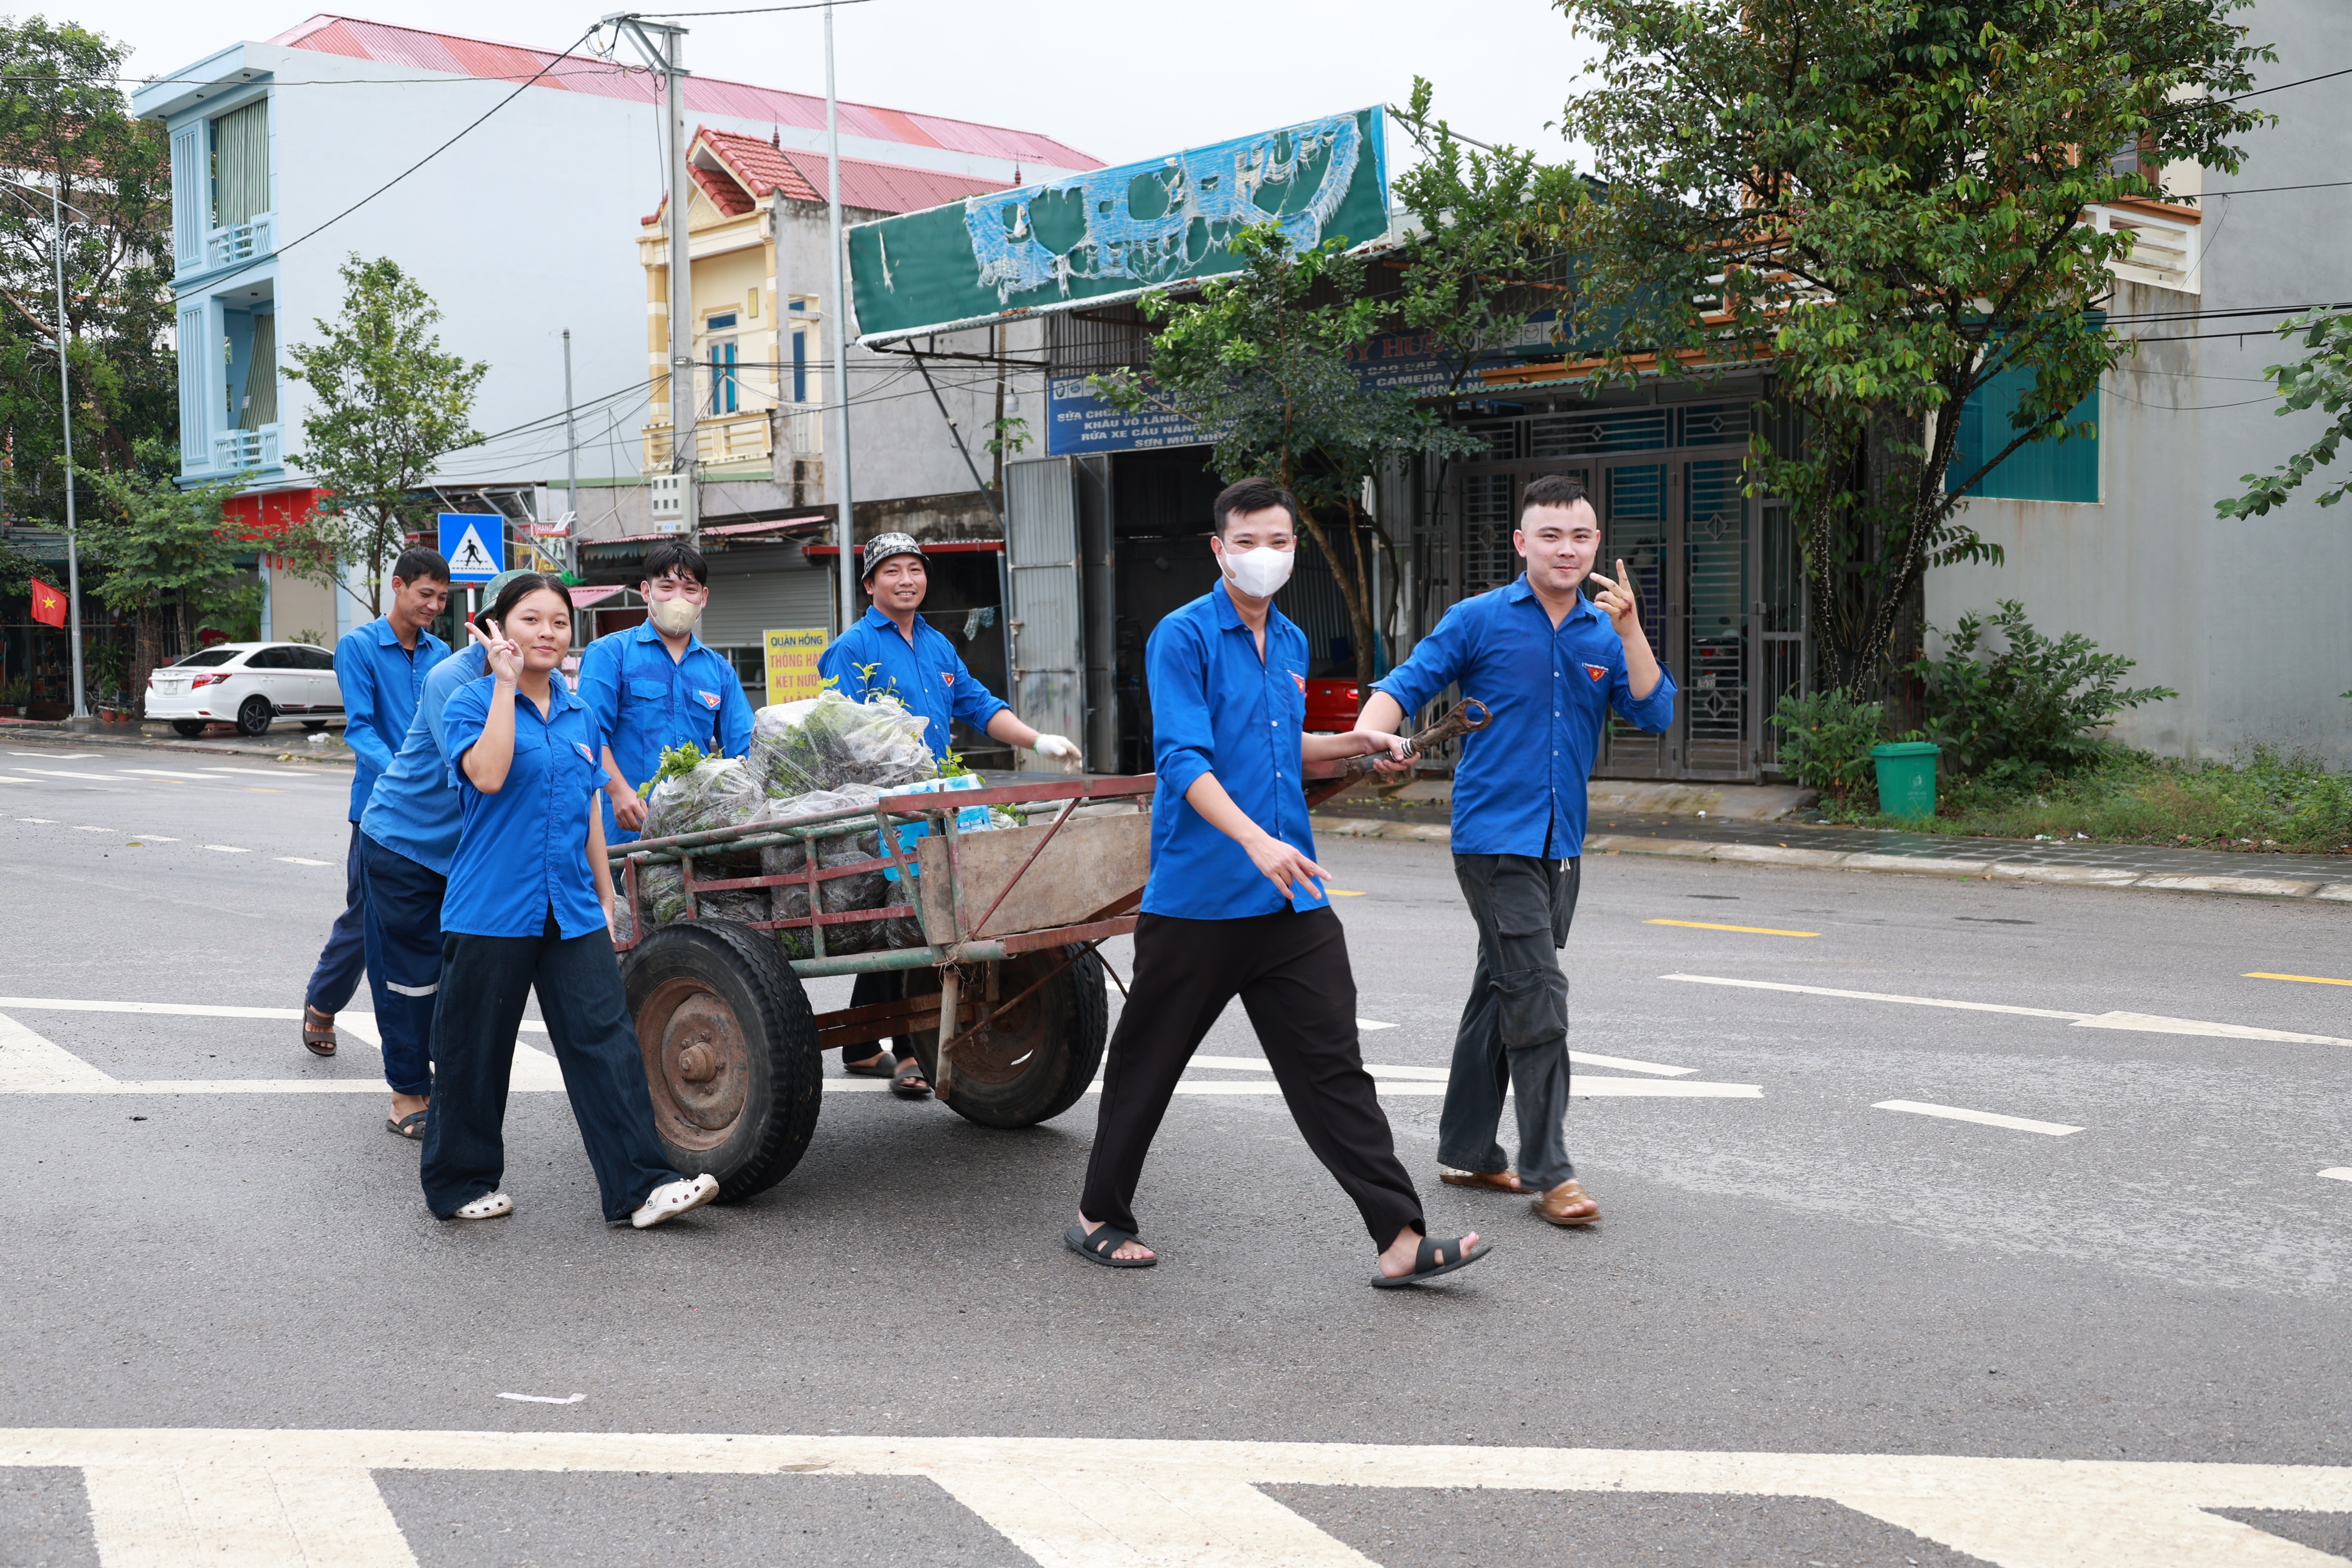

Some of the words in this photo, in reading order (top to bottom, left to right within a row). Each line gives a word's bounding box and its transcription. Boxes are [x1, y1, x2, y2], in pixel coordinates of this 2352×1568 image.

[1367, 365, 1399, 375] CAO
[1057, 410, 1082, 422] SỬA
[1376, 373, 1445, 386] CAMERA
[1084, 419, 1119, 430] KHÂU
[1123, 417, 1139, 426] VÔ
[1144, 413, 1179, 424] LĂNG
[1082, 430, 1108, 441] RỬA
[1135, 438, 1162, 447] SƠN
[1167, 435, 1194, 445] MỚI
[534, 524, 553, 532] TRANG
[771, 635, 796, 646] QUÂN
[770, 652, 803, 668] THÔNG
[806, 651, 822, 667] HÀ
